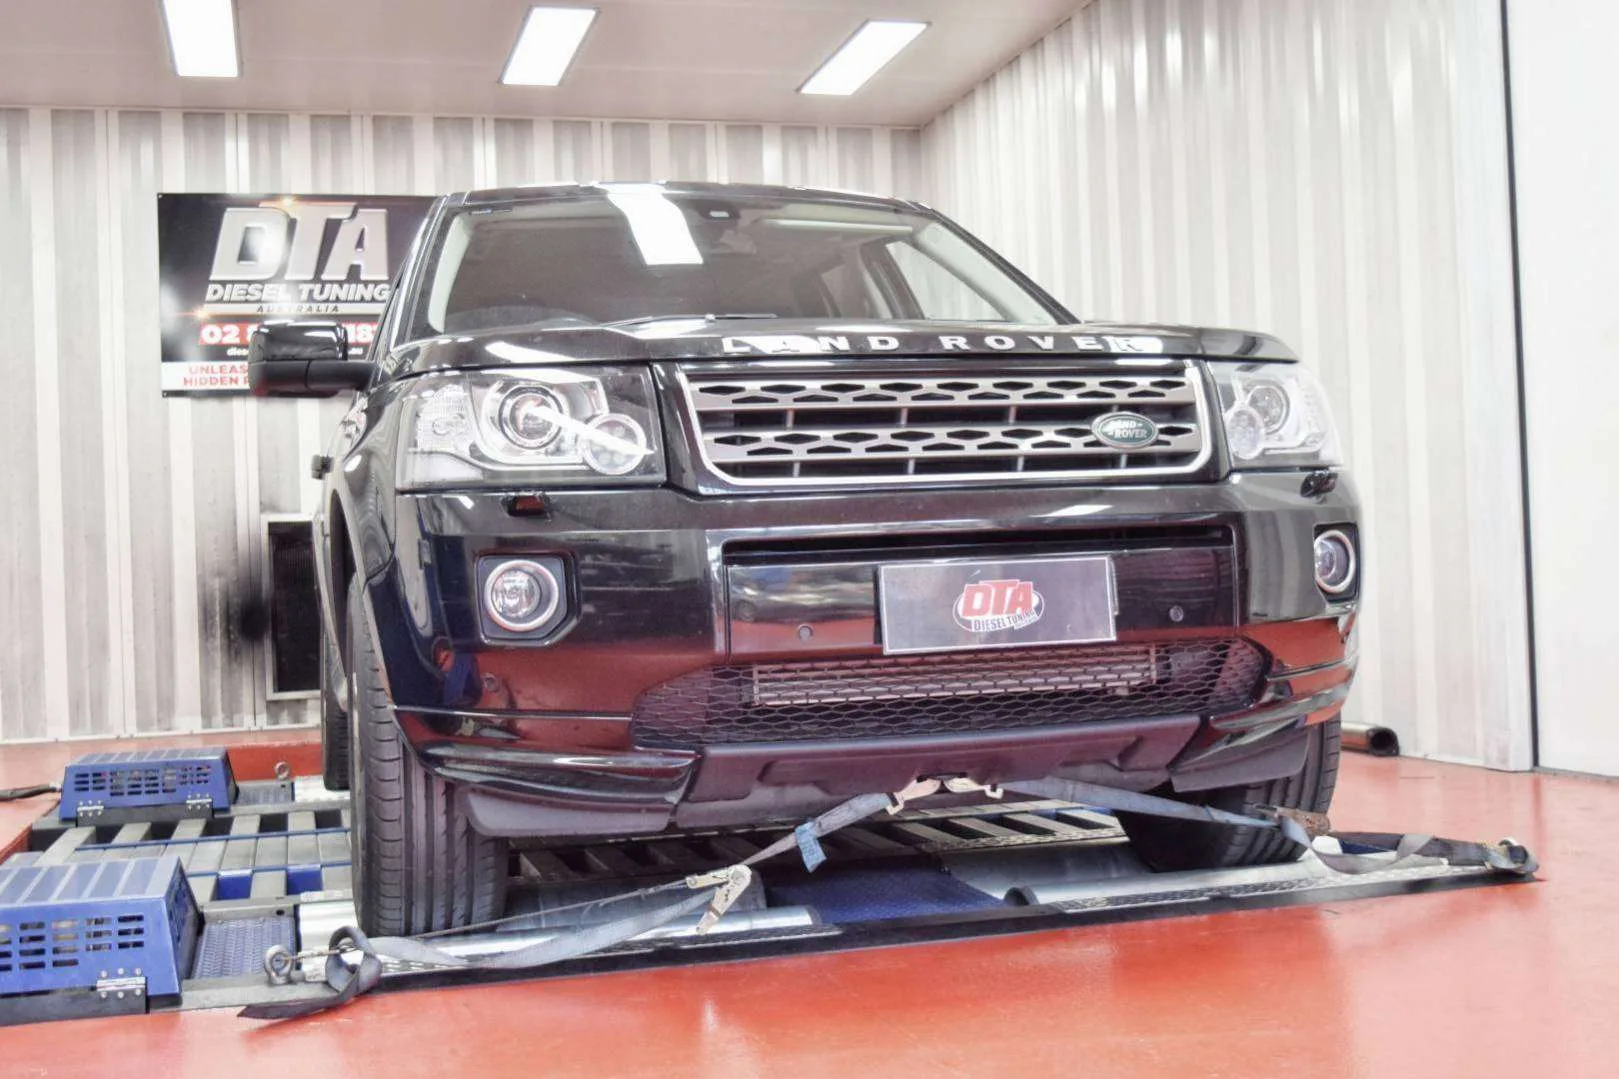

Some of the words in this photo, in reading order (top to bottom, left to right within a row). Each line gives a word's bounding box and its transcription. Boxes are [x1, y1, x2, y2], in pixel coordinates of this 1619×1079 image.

[209, 202, 389, 281] DTA
[205, 283, 292, 302] DIESEL
[298, 283, 390, 302] TUNING
[256, 304, 339, 313] AUTRALIA
[722, 335, 899, 354] LAND
[938, 335, 1143, 352] ROVER
[183, 375, 240, 387] HIDDEN
[1114, 428, 1148, 439] ROVER
[961, 579, 1035, 618] DTA
[973, 617, 1008, 631] DIESEL
[1006, 607, 1036, 625] TUNING
